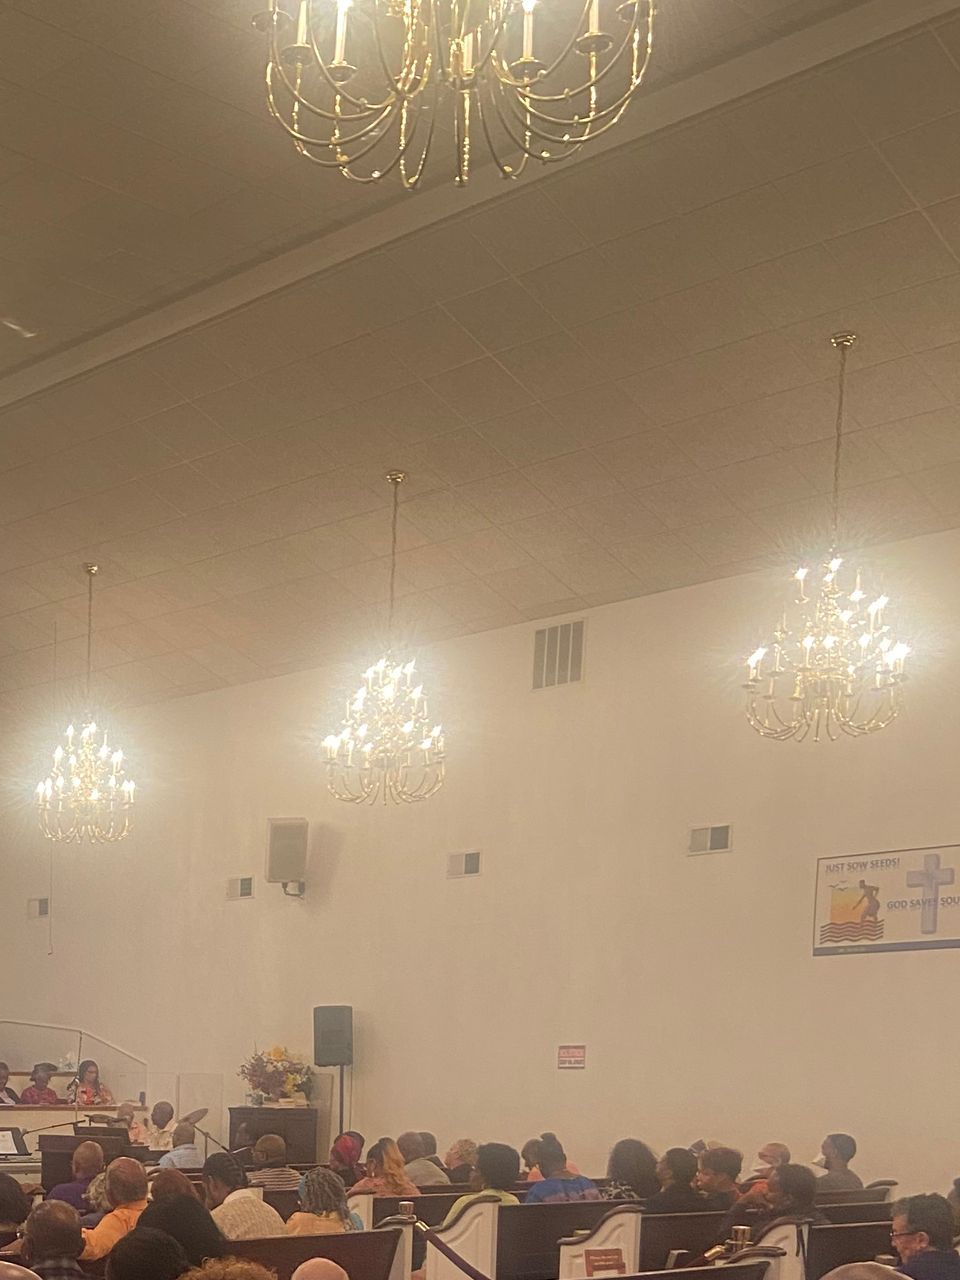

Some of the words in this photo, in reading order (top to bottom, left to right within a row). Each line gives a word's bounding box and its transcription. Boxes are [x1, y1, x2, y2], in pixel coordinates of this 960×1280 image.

[825, 863, 845, 873] JUST
[847, 861, 868, 871] SOW
[870, 857, 901, 868] SEEDS!
[887, 900, 908, 909] GOD
